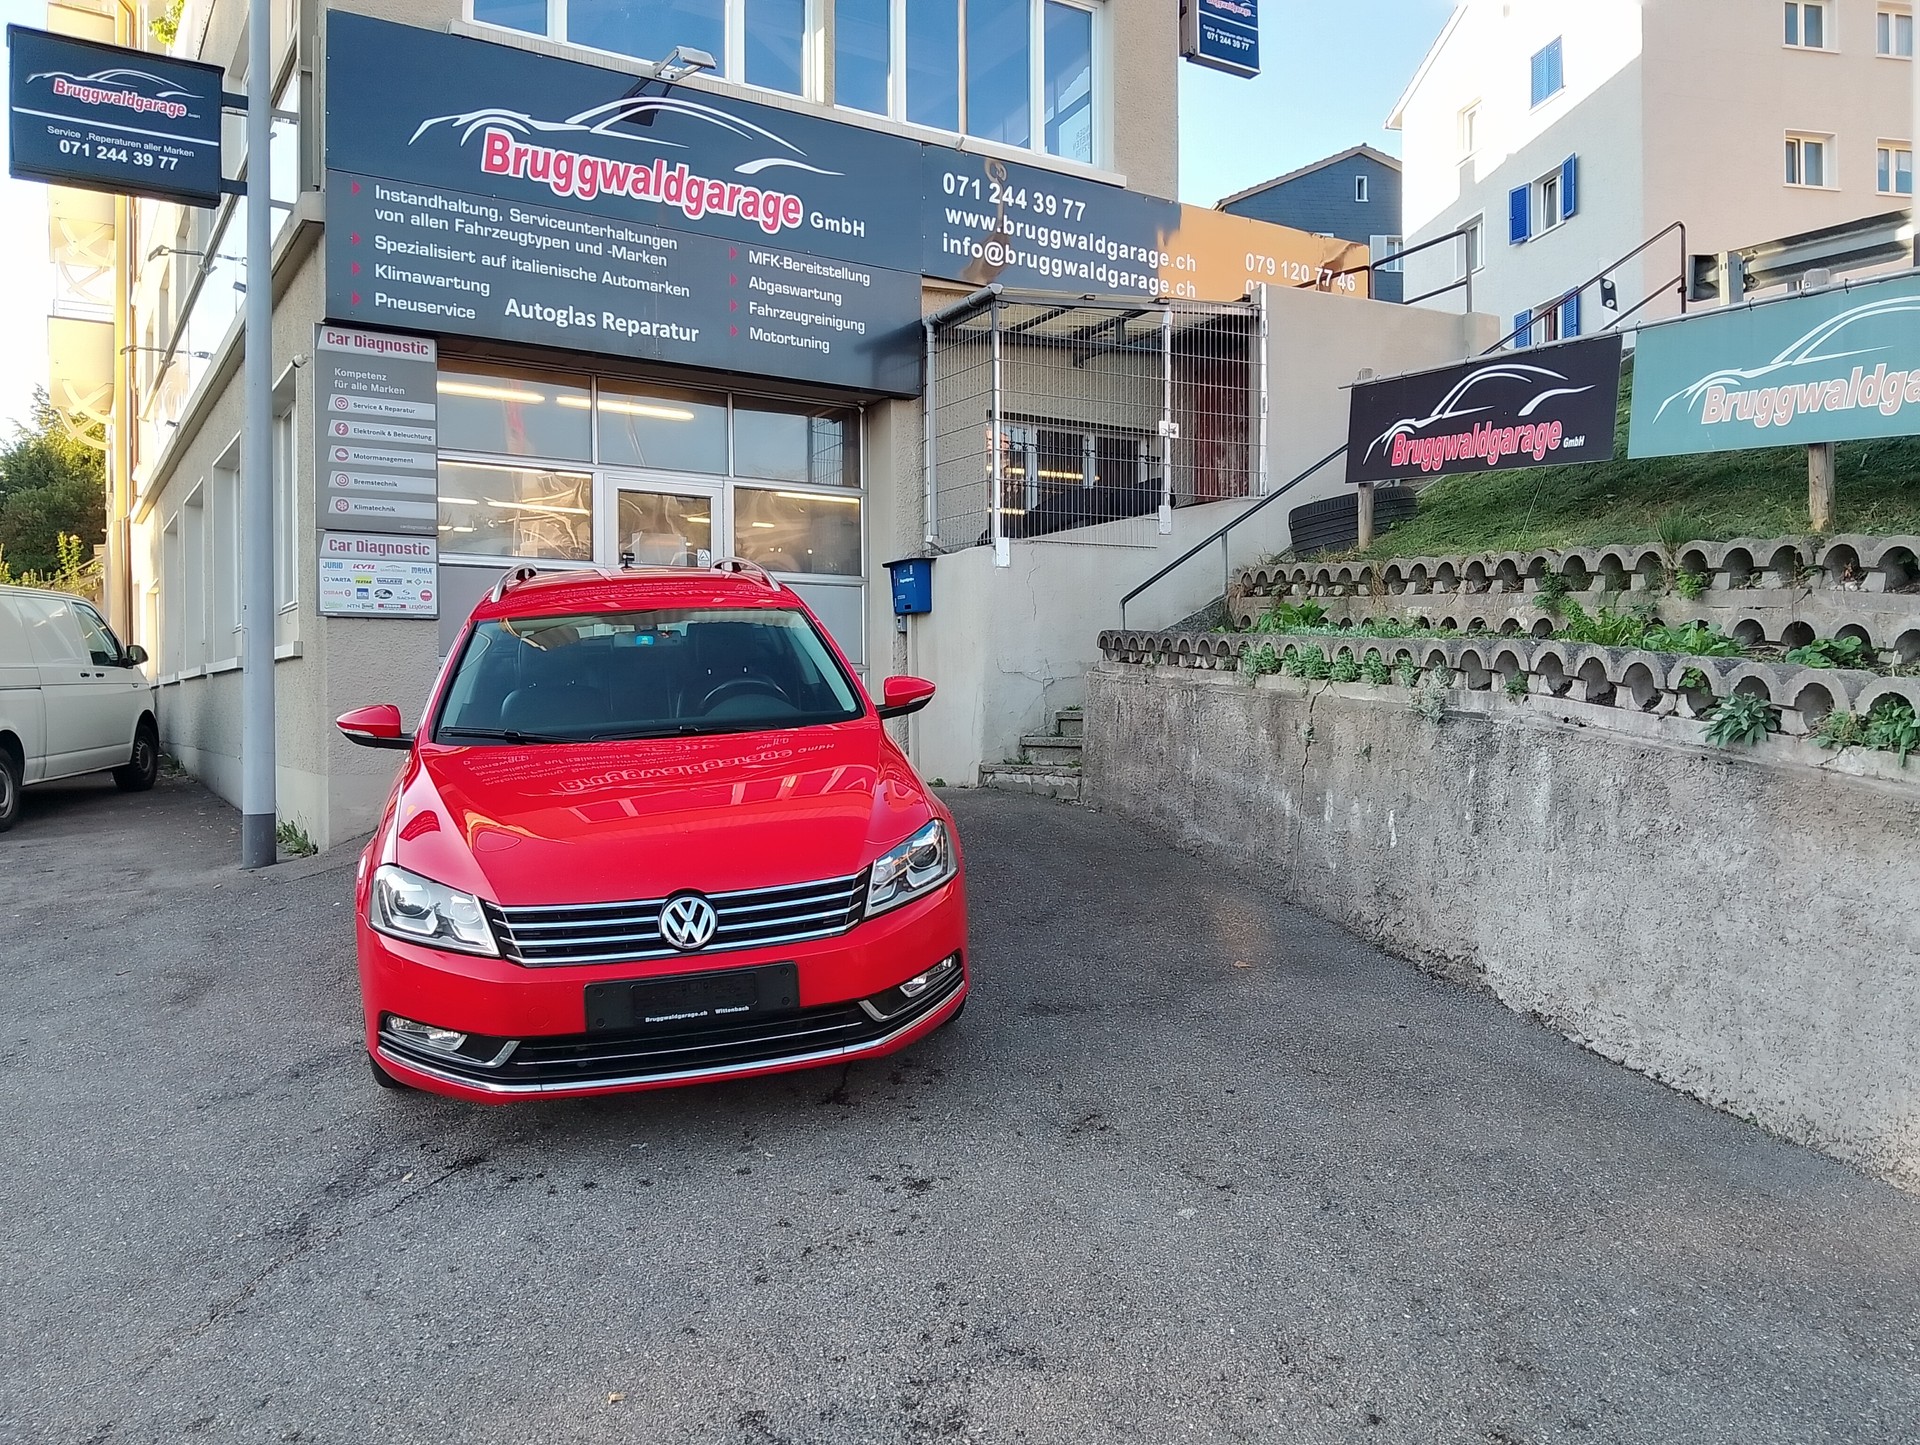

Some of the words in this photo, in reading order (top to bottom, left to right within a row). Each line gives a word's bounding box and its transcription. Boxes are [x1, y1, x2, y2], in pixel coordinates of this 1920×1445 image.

[1206, 31, 1218, 41] 071
[1219, 35, 1231, 46] 244
[1232, 39, 1240, 48] 39
[1241, 42, 1250, 51] 77
[53, 77, 187, 119] Bruggwaldgarage
[47, 125, 81, 139] Service
[143, 143, 162, 152] aller
[163, 145, 195, 157] Marken
[59, 139, 90, 157] 071
[97, 146, 129, 163] 244
[133, 152, 153, 166] 39
[158, 156, 178, 170] 77
[481, 127, 803, 234] Bruggwaldgarage
[809, 211, 865, 237] GmbH
[943, 172, 981, 200] 071
[988, 182, 1027, 210] 244
[1033, 192, 1057, 216] 39
[1062, 197, 1086, 222] 77
[375, 184, 503, 222] Instandhaltung,
[509, 208, 678, 250] Serviceunterhaltungen
[375, 208, 404, 224] von
[410, 213, 448, 230] allen
[455, 219, 570, 251] Fahrzeugtypen
[575, 241, 602, 256] und
[607, 244, 667, 267] -Marken
[945, 207, 1196, 272] www.bruggwaldgarage.ch
[375, 235, 476, 264] Spezialisiert
[481, 252, 507, 268] auf
[512, 258, 597, 283] italienische
[602, 271, 690, 298] Automarken
[375, 263, 491, 297] Klimawartung
[748, 250, 871, 286] MFK-Bereitstellung
[943, 232, 1196, 298] info@bruggwaldgarage.ch
[1245, 252, 1276, 276] 079
[1281, 260, 1310, 283] 120
[1314, 267, 1334, 287] 77
[1337, 272, 1356, 292] 46
[748, 276, 842, 306] Abgaswartung
[375, 292, 477, 320] Pneuservice
[504, 298, 597, 328] Autoglas
[602, 311, 700, 343] Reparatur
[749, 301, 866, 334] Fahrzeugreinigung
[326, 331, 350, 345] Car
[354, 334, 429, 356] Diagnostic
[749, 327, 830, 353] Motortuning
[334, 367, 387, 381] Kompetenz
[334, 379, 348, 388] für
[351, 382, 368, 391] alle
[370, 383, 405, 395] Marken
[353, 402, 377, 411] Service
[384, 405, 416, 414] Reparatur
[353, 427, 386, 437] Elektronik
[393, 431, 432, 441] Beleuchtung
[1391, 419, 1562, 472] Bruggwaldgarage
[1563, 435, 1585, 448] GmbH
[353, 453, 414, 464] Motormanagement
[353, 478, 398, 487] Bremstechnik
[353, 504, 396, 512] Klimatechnik
[329, 538, 352, 552] Car
[356, 539, 430, 557] Diagnostic
[645, 1011, 708, 1023] Bruggwaldgarage.ch
[715, 1006, 750, 1014] Wittenbach
